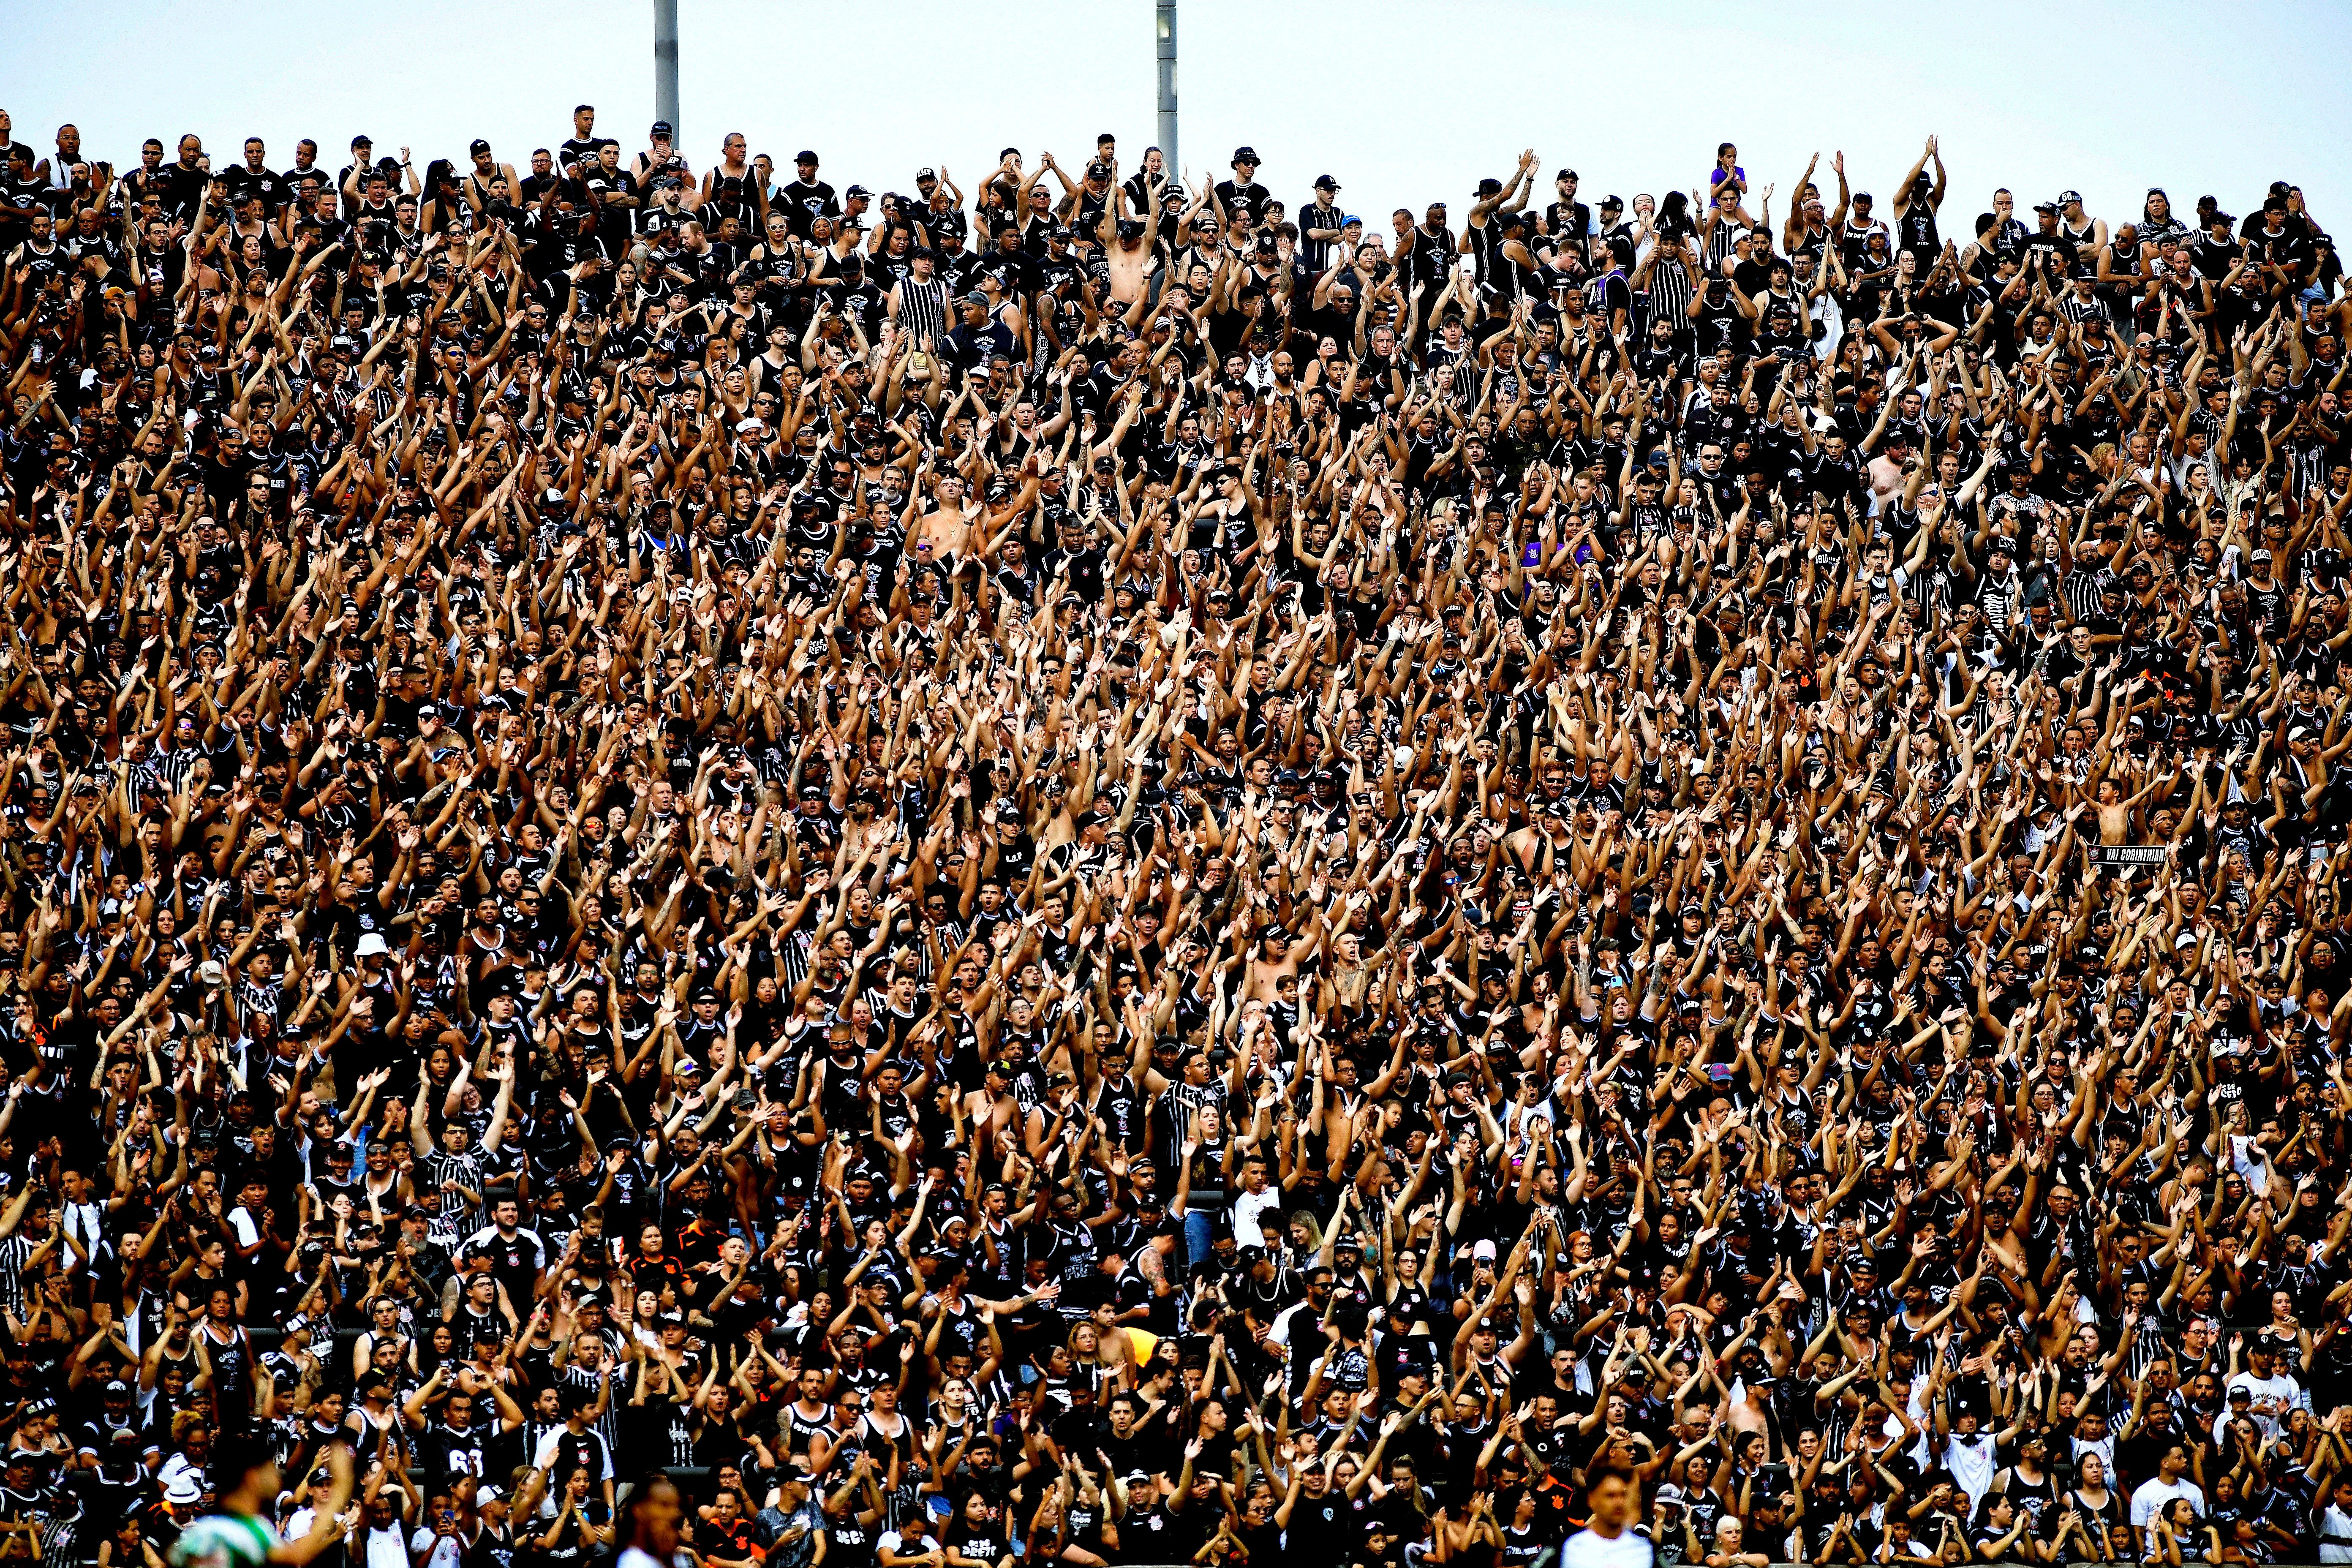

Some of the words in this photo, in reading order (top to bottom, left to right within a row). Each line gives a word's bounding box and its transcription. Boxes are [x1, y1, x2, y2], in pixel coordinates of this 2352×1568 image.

[916, 169, 931, 177] LHP
[2106, 848, 2119, 860] VAI
[2030, 945, 2047, 954] LHP
[1682, 1000, 1700, 1010] LHP
